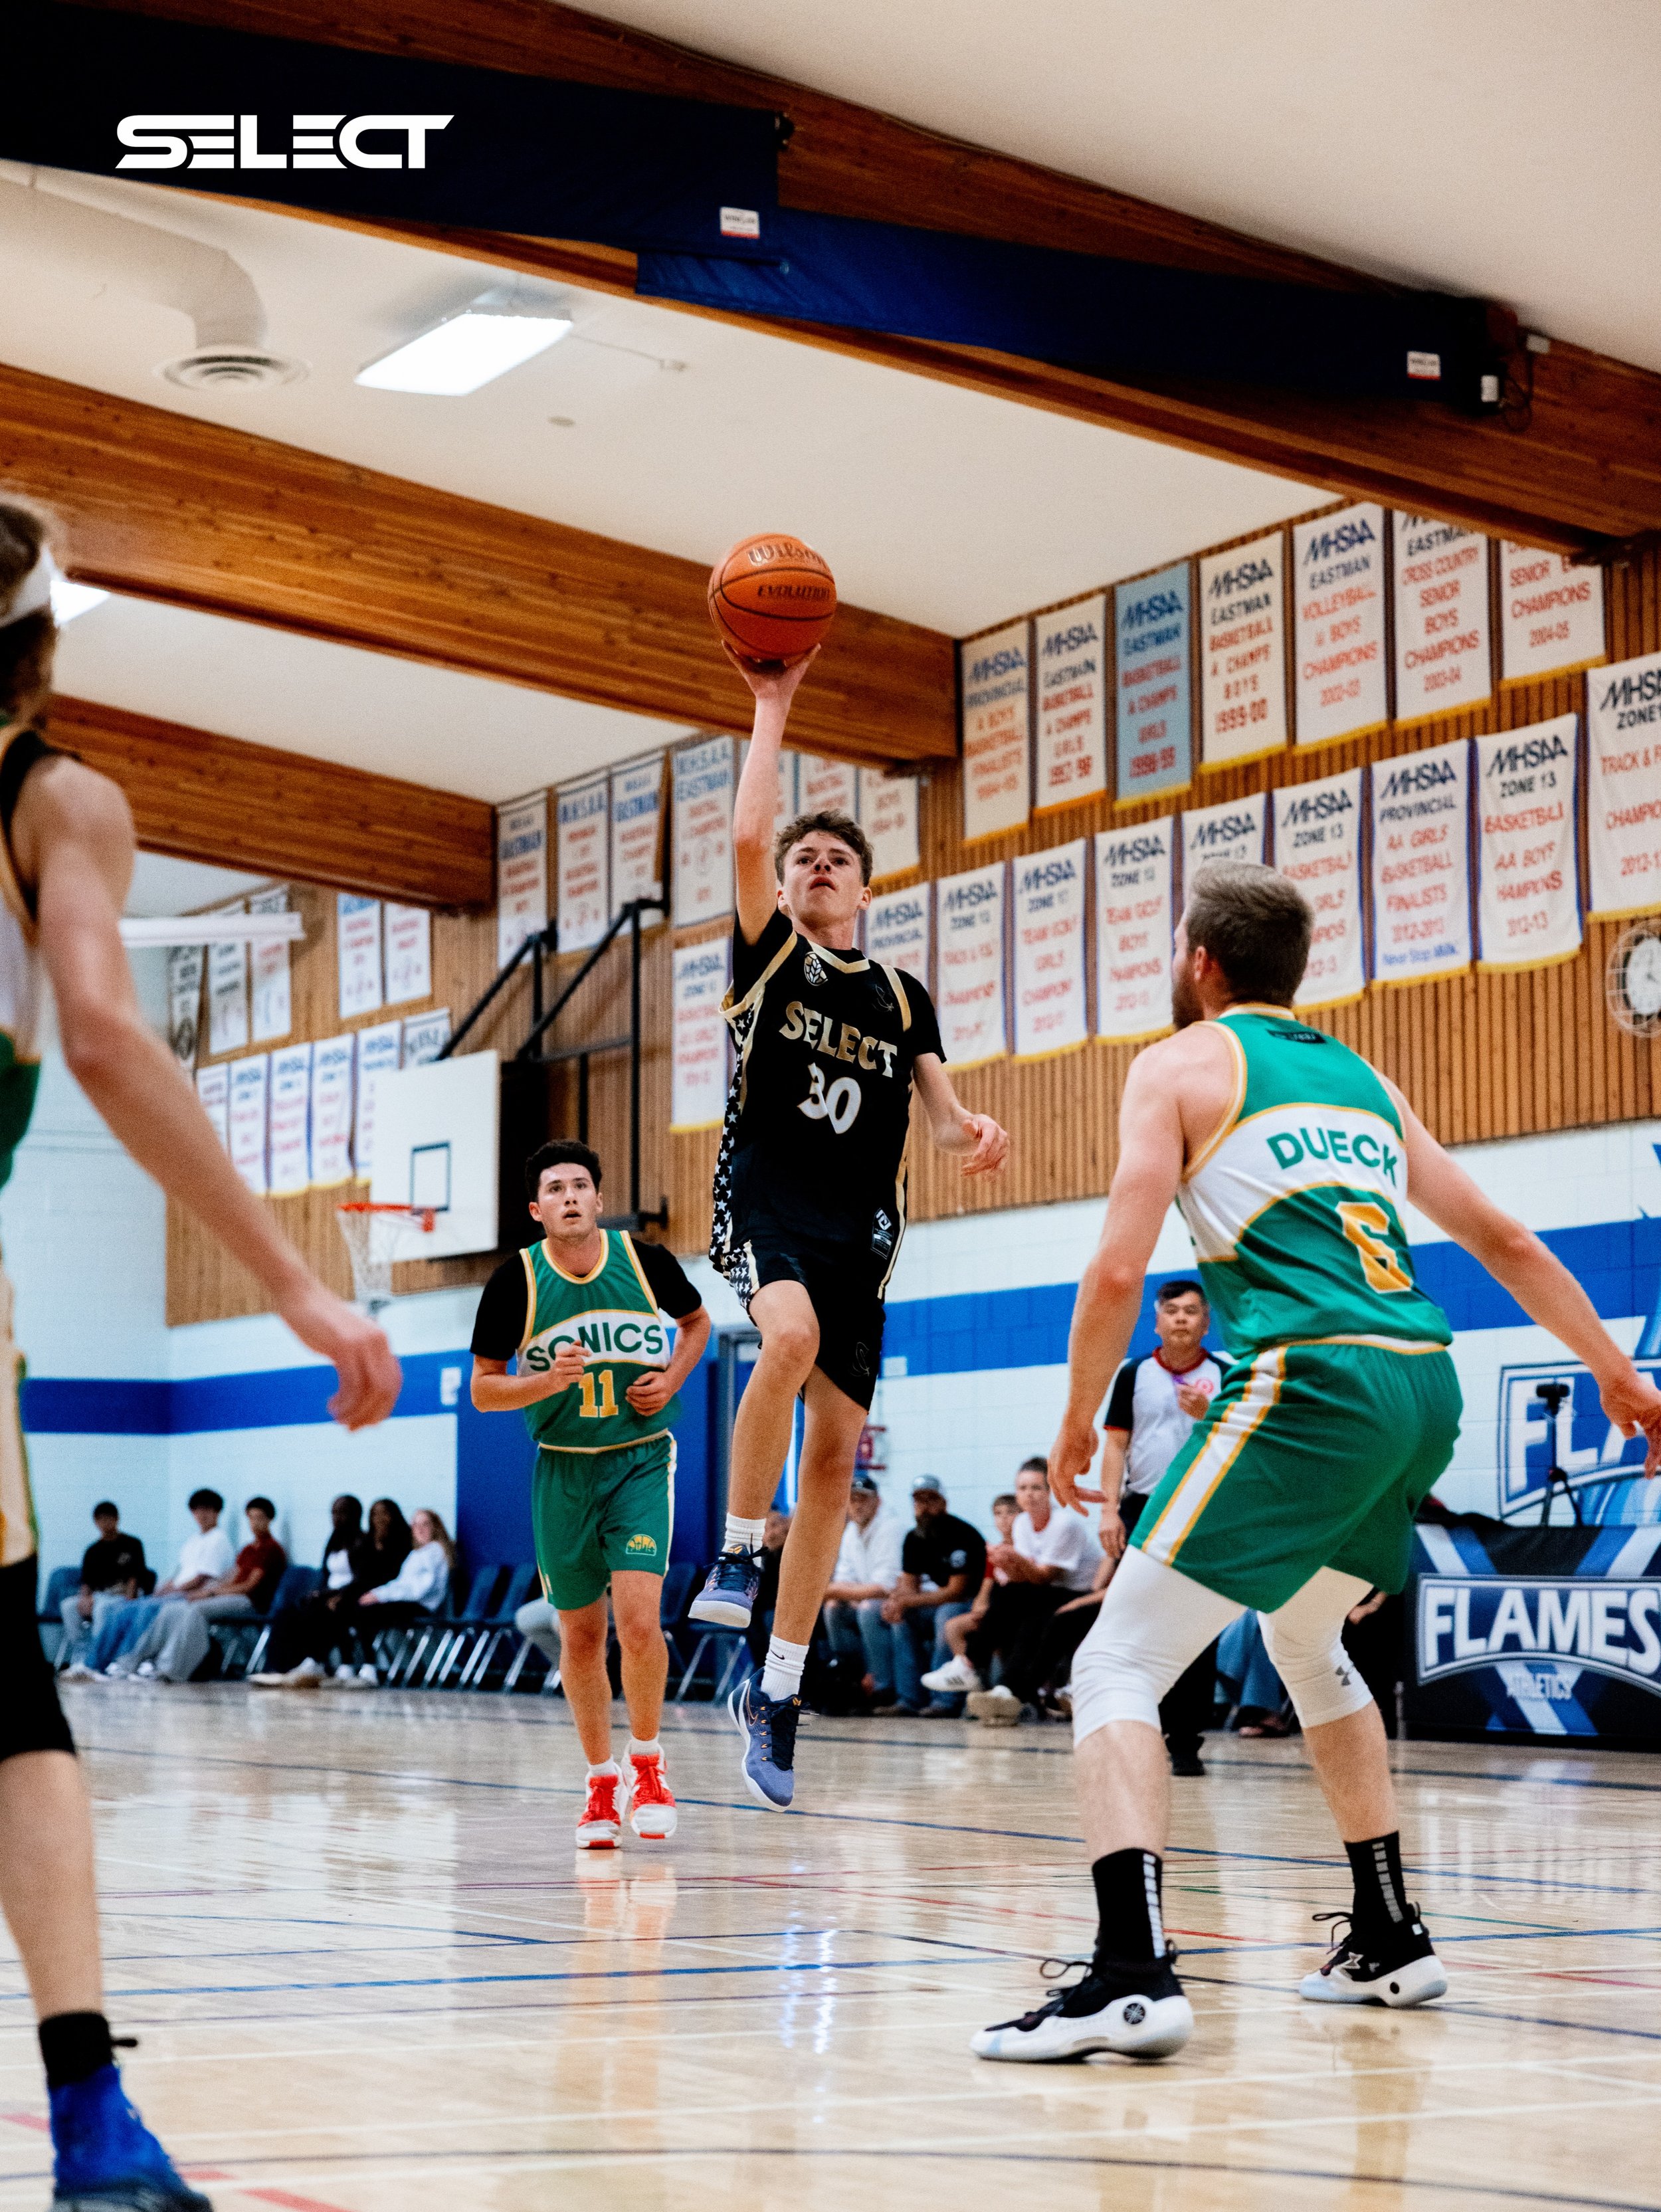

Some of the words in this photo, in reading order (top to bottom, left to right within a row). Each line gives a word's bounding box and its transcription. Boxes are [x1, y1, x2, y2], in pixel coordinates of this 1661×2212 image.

[1302, 518, 1376, 566] MHSAA
[1209, 559, 1274, 599] MHSAA
[1309, 554, 1371, 591] EASTMAN
[1510, 559, 1551, 588] SENIOR
[1122, 589, 1183, 629] MHSAA
[1211, 592, 1271, 627] EASTMAN
[1511, 580, 1591, 619] CHAMPIONS
[1042, 621, 1098, 657] MHSAA
[1329, 615, 1361, 643] BOYS
[1425, 607, 1458, 636] BOYS
[1302, 639, 1378, 681] CHAMPIONS
[1405, 629, 1480, 670] CHAMPIONS
[1616, 704, 1656, 730] ZONE
[1485, 734, 1569, 778] MHSAA
[1379, 757, 1458, 800] MHSAA
[1500, 774, 1536, 799] ZONE
[1540, 769, 1557, 789] 13
[1281, 787, 1354, 829] MHSAA
[1379, 791, 1457, 825] PROVINCIAL
[1104, 833, 1166, 867] MHSAA
[1189, 811, 1257, 851] MHSAA
[1292, 827, 1326, 849] ZONE
[1381, 850, 1454, 886] BASKETBALL
[1386, 882, 1448, 913] FINALISTS
[779, 1001, 898, 1078] SELECT
[797, 1062, 862, 1134] 30
[1266, 1127, 1399, 1186] DUECK
[1335, 1201, 1413, 1294] 6
[578, 1369, 619, 1418] 11
[1424, 1588, 1661, 1676] FLAMES
[1506, 1673, 1573, 1700] ATHLETICS
